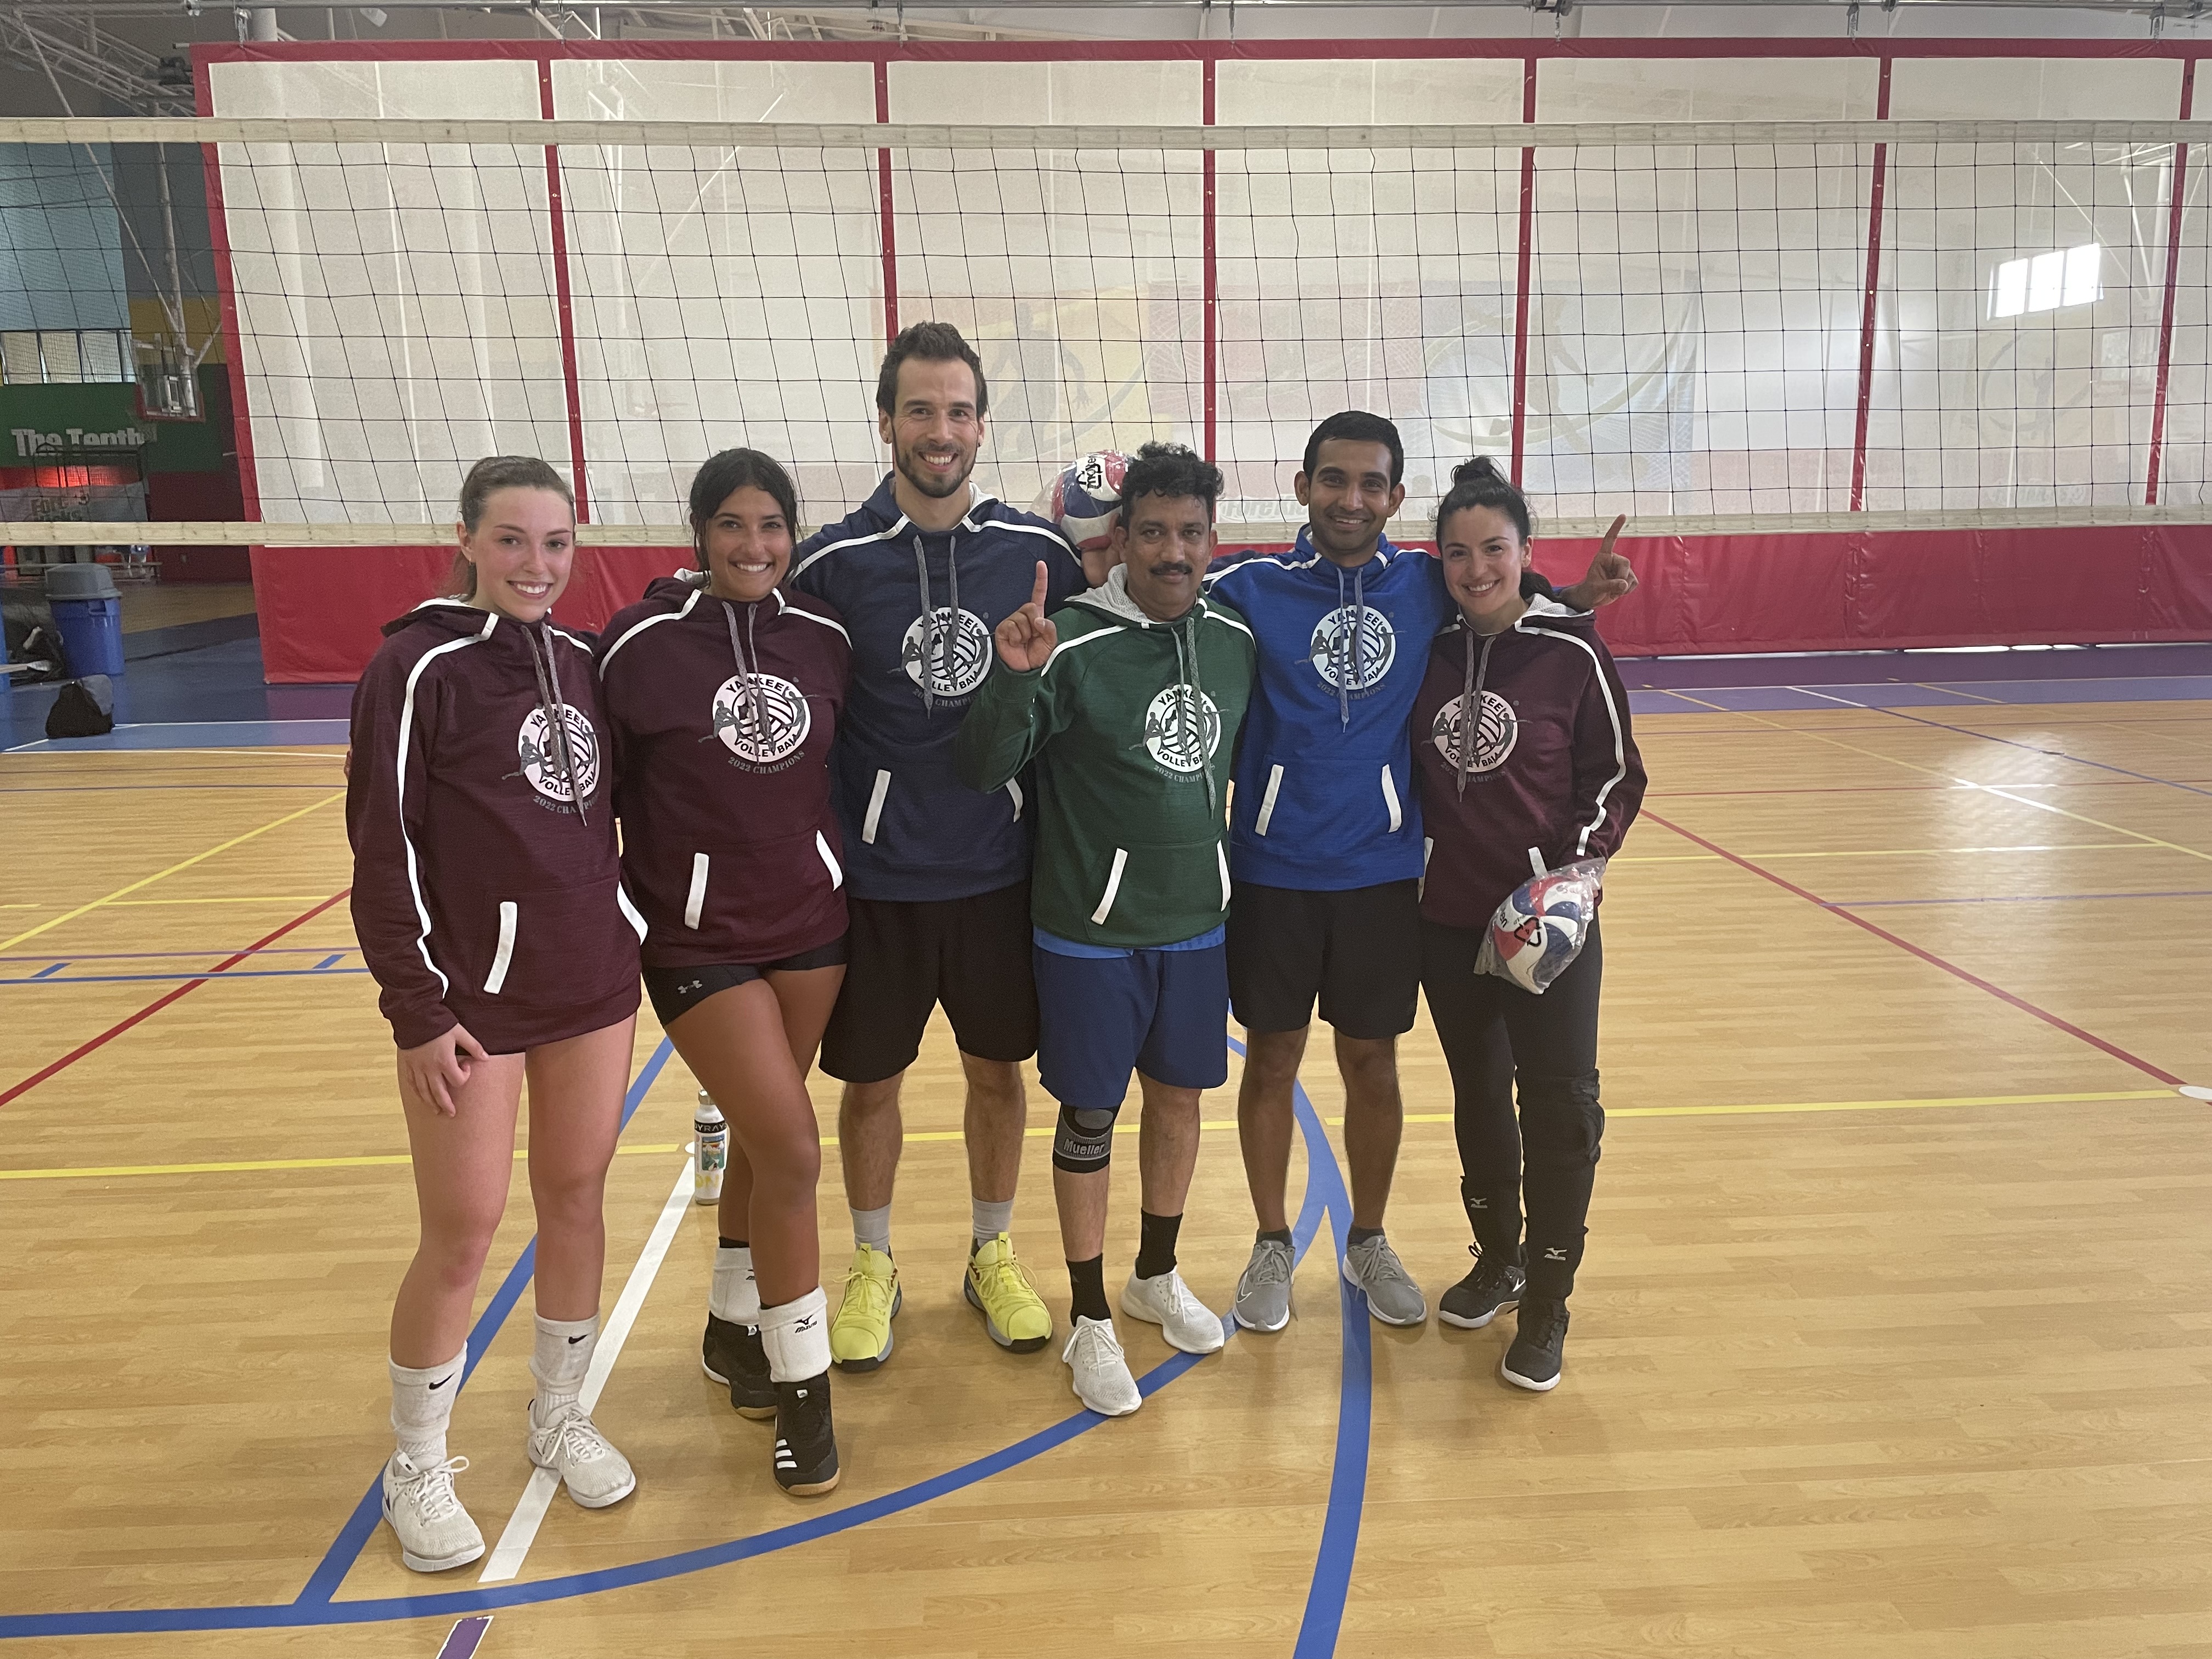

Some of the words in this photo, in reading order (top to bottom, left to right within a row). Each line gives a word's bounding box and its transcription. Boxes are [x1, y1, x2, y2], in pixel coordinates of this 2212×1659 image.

[727, 757, 752, 772] 2022
[753, 750, 805, 774] CHAMPIONS
[1157, 747, 1204, 767] VOLLEYBA
[1154, 764, 1173, 780] 2022
[533, 794, 556, 811] 2022
[1063, 1138, 1105, 1155] Mueller
